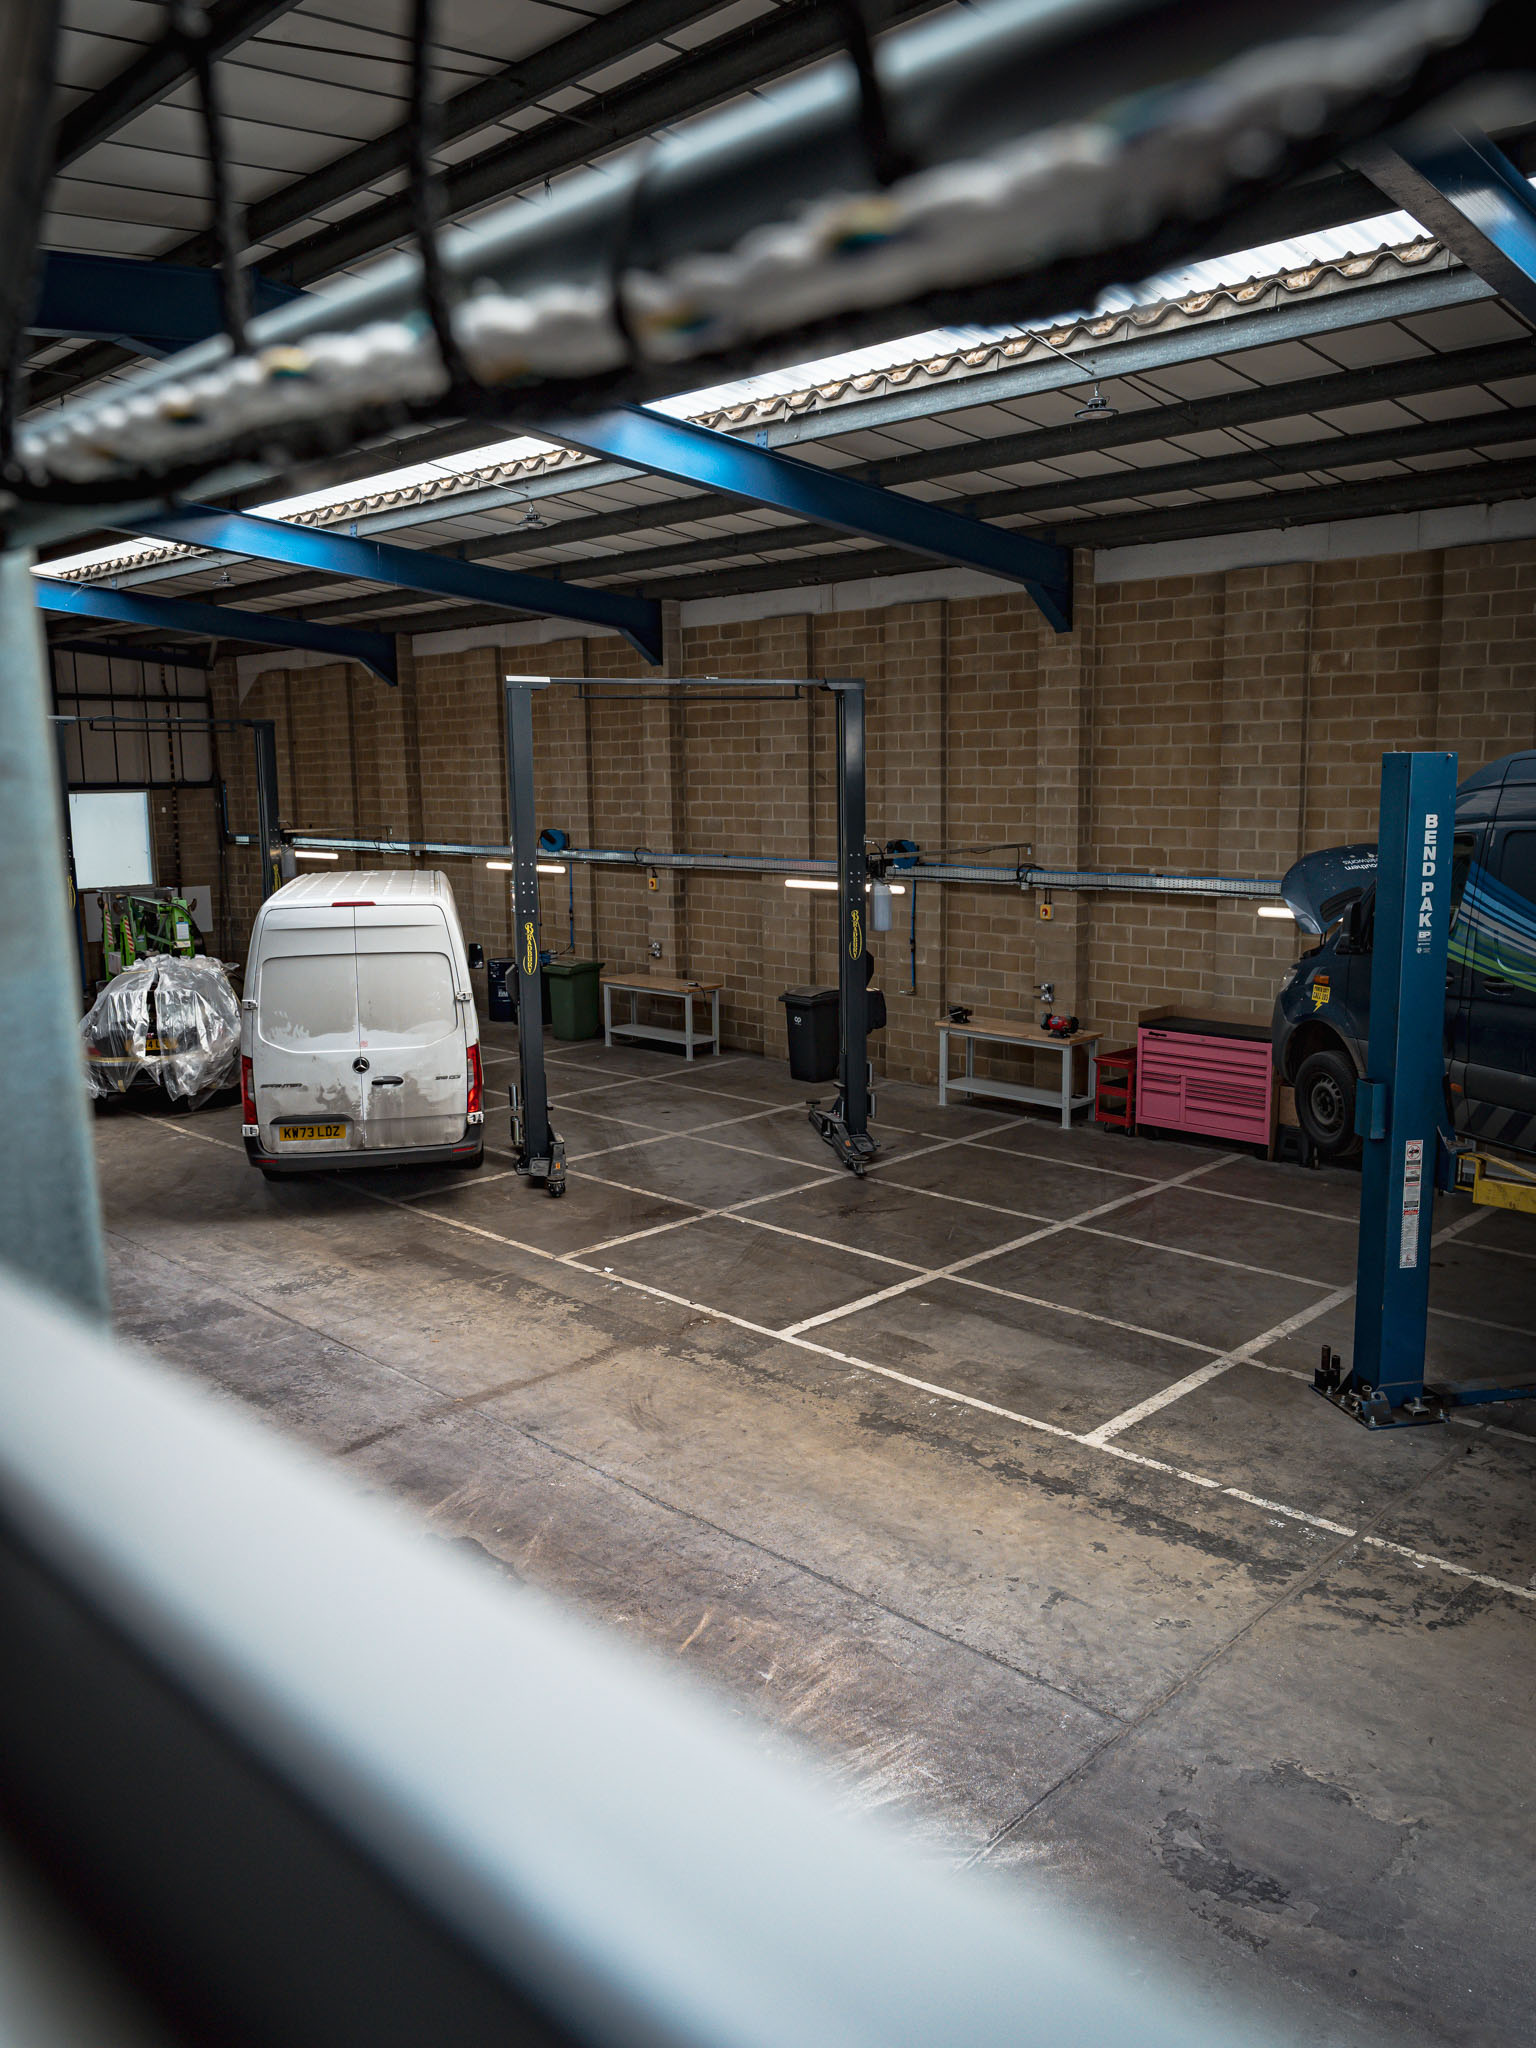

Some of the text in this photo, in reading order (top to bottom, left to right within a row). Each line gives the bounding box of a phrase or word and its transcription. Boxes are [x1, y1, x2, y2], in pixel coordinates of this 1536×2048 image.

[1422, 814, 1438, 876] BEND
[1419, 882, 1434, 927] PAK
[284, 1125, 340, 1138] KW73 LDZ
